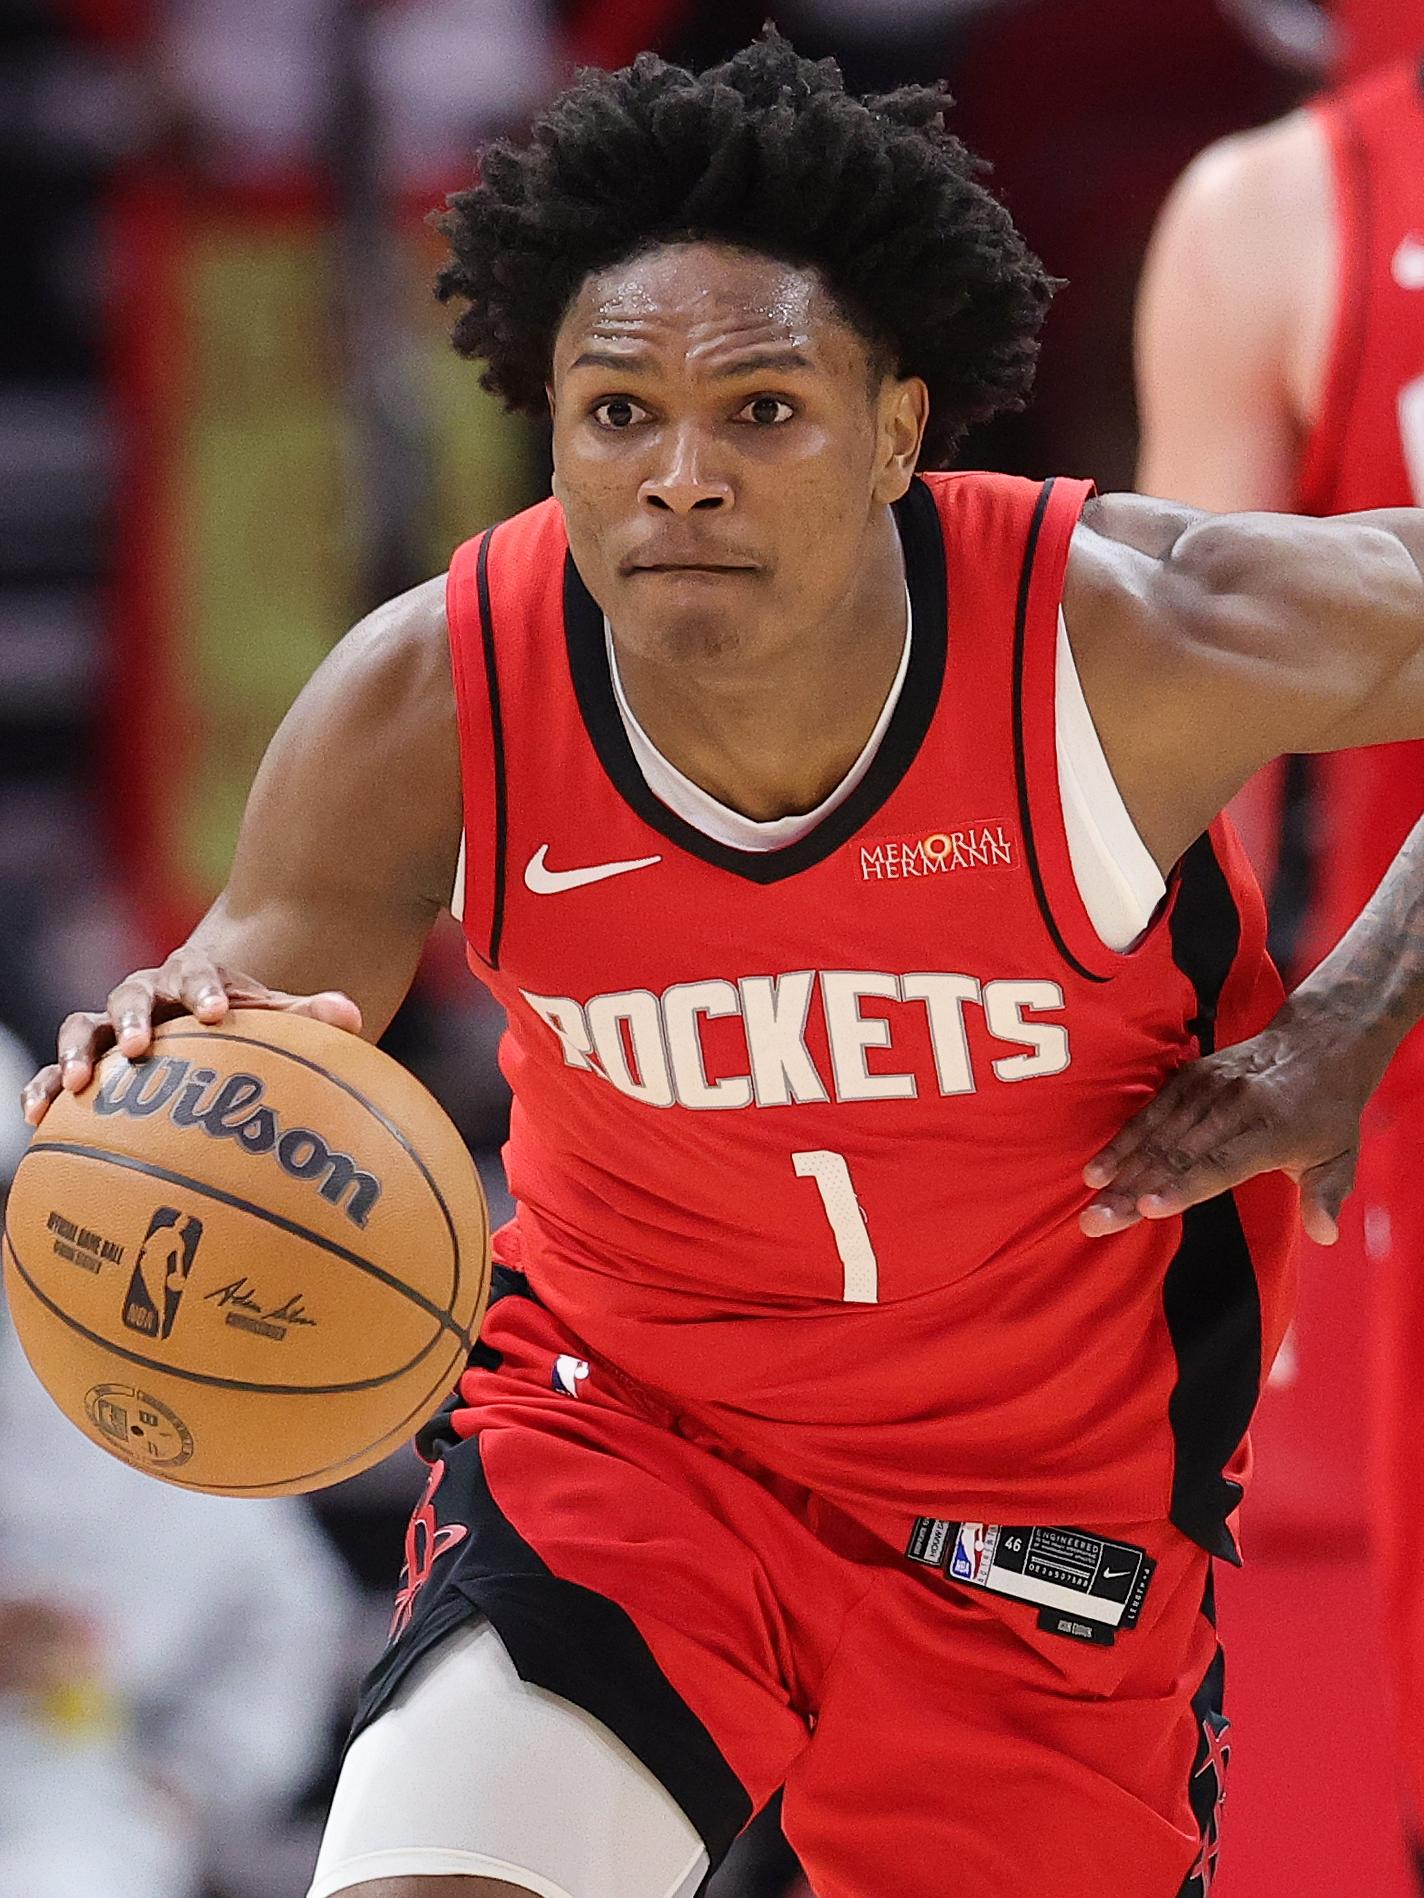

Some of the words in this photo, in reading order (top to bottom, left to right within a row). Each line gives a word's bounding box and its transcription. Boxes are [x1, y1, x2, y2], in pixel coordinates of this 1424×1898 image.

[860, 826, 1011, 866] MEMORIAL
[862, 844, 1012, 881] HERMANN
[518, 969, 1072, 1110] ROCKETS
[93, 1055, 384, 1231] Wilson
[790, 1149, 879, 1304] 1
[1004, 1535, 1022, 1553] 46
